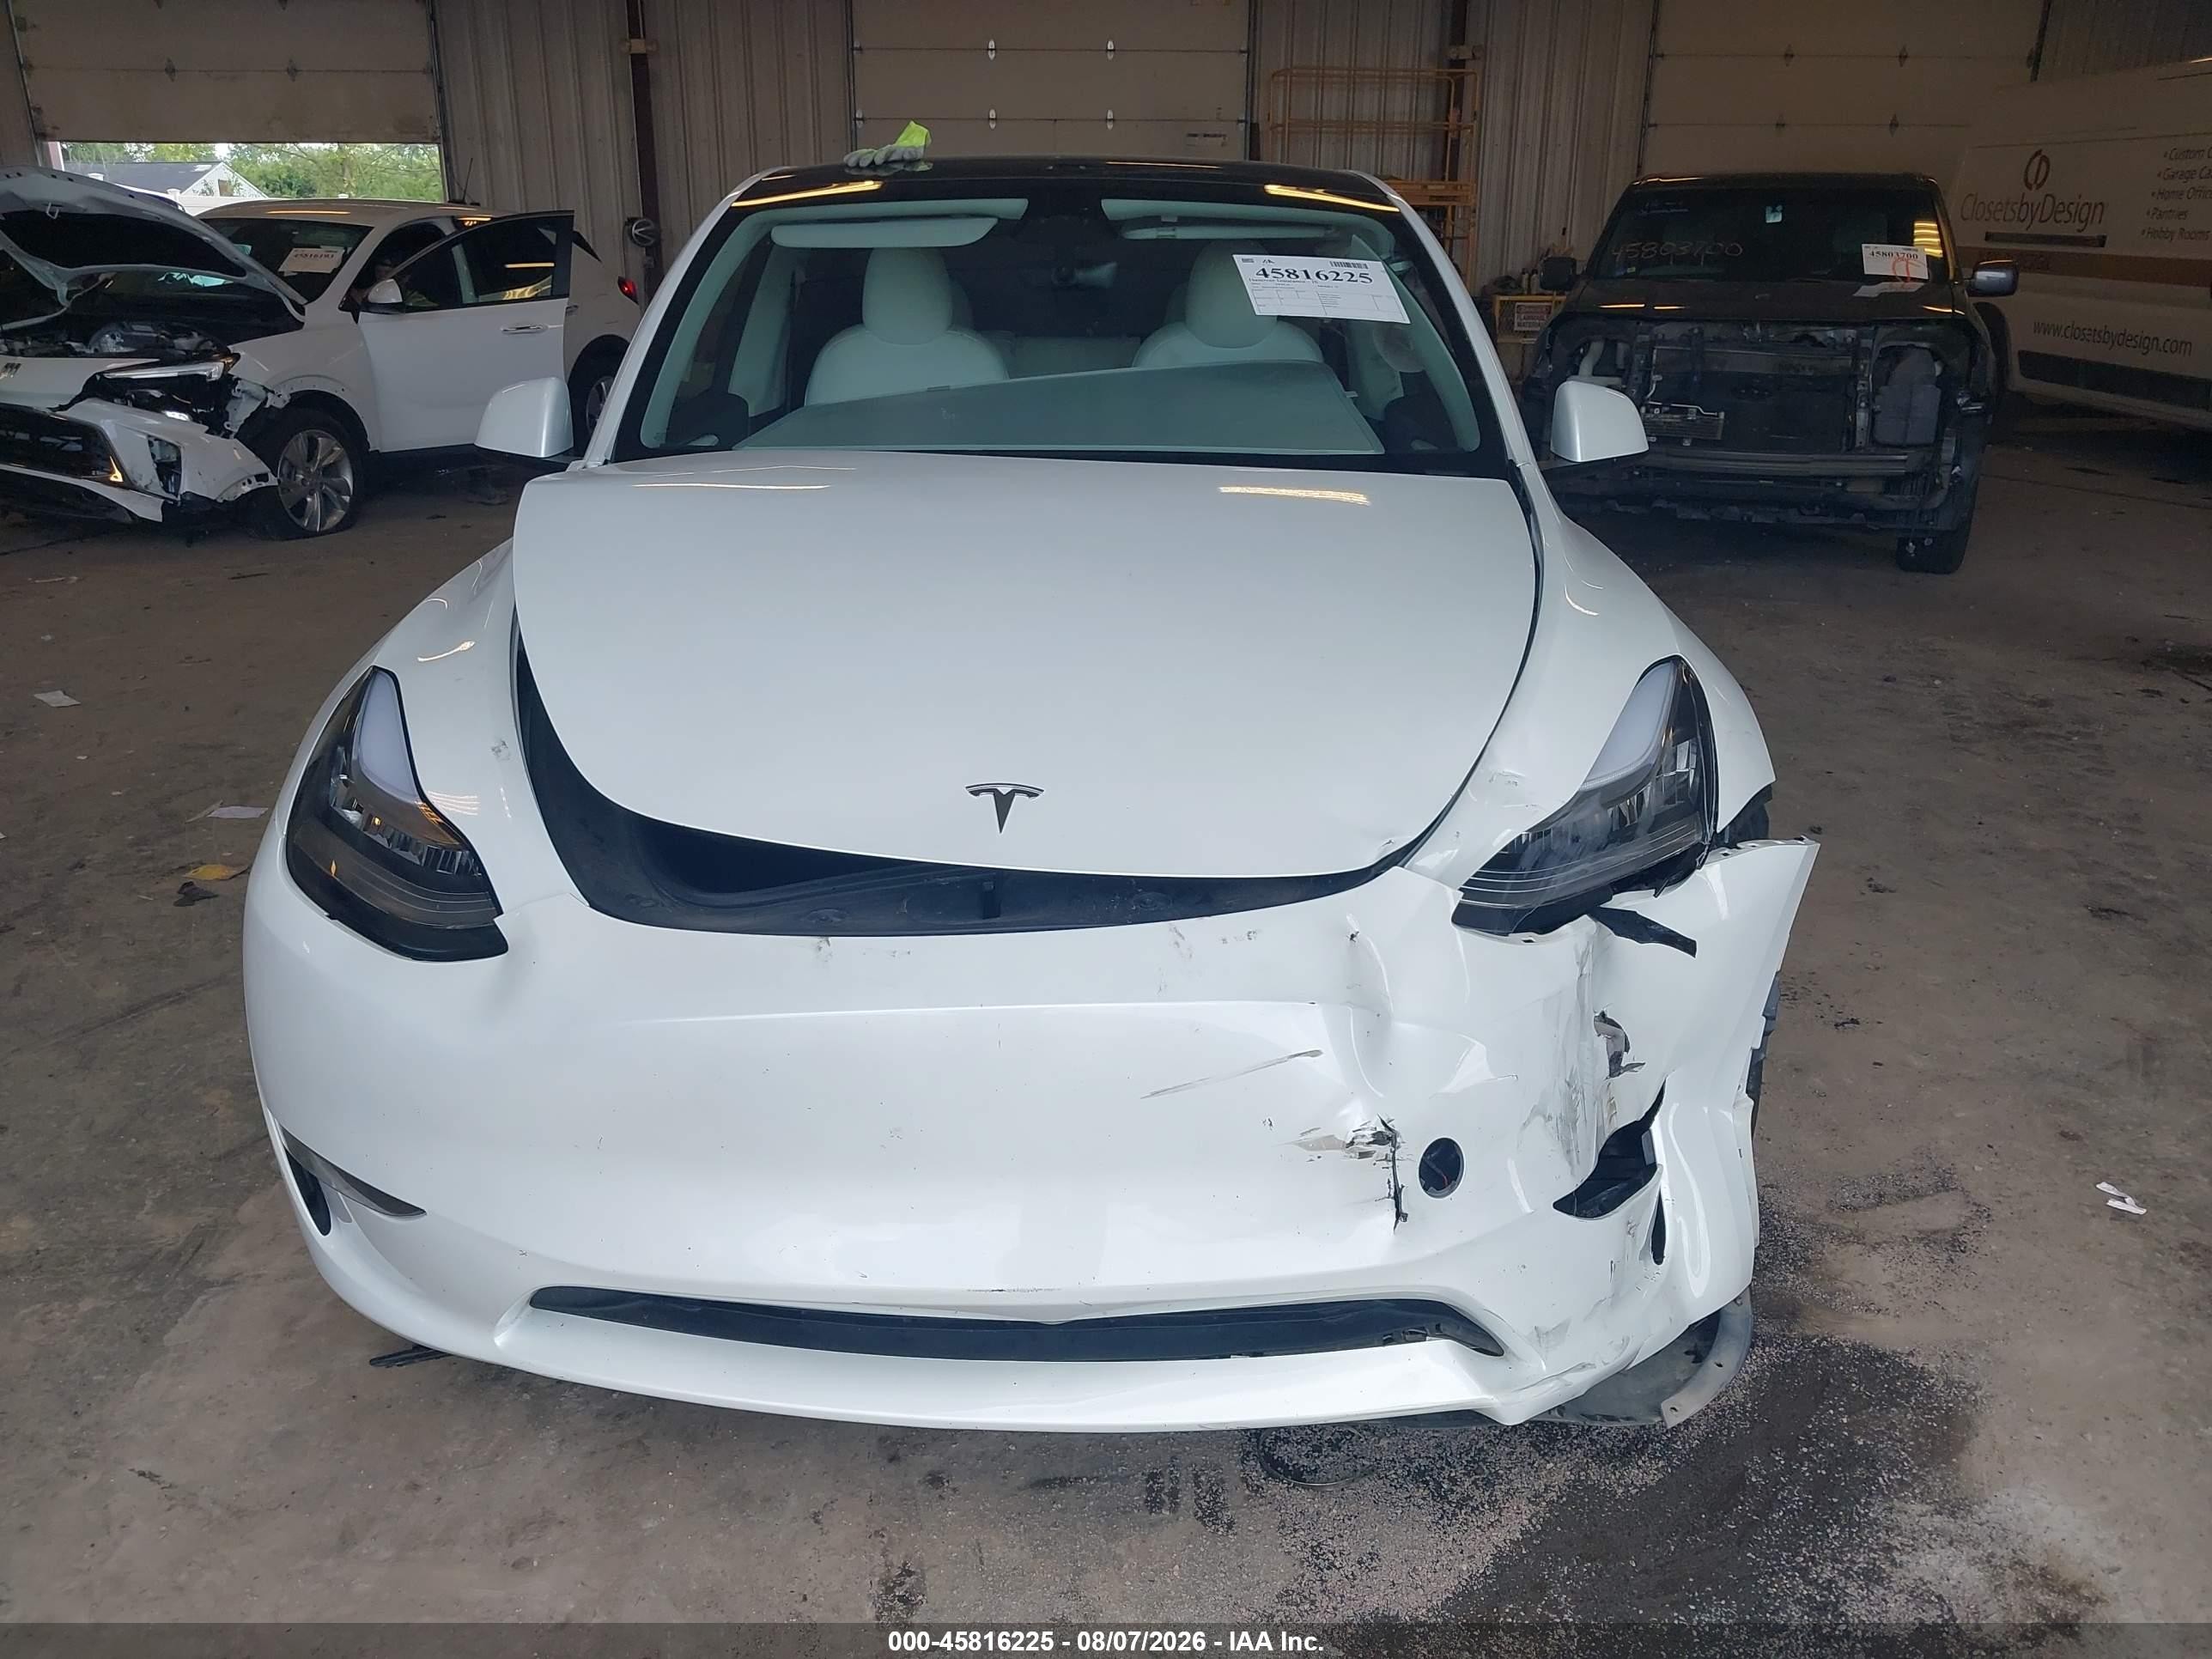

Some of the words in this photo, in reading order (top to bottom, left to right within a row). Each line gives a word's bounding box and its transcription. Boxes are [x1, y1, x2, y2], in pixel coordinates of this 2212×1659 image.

[2169, 148, 2205, 160] Custom
[2164, 167, 2197, 183] Garage
[2157, 188, 2184, 199] Home
[1255, 267, 1373, 284] 45816225
[2033, 320, 2192, 357] www.closetsbydesign.com
